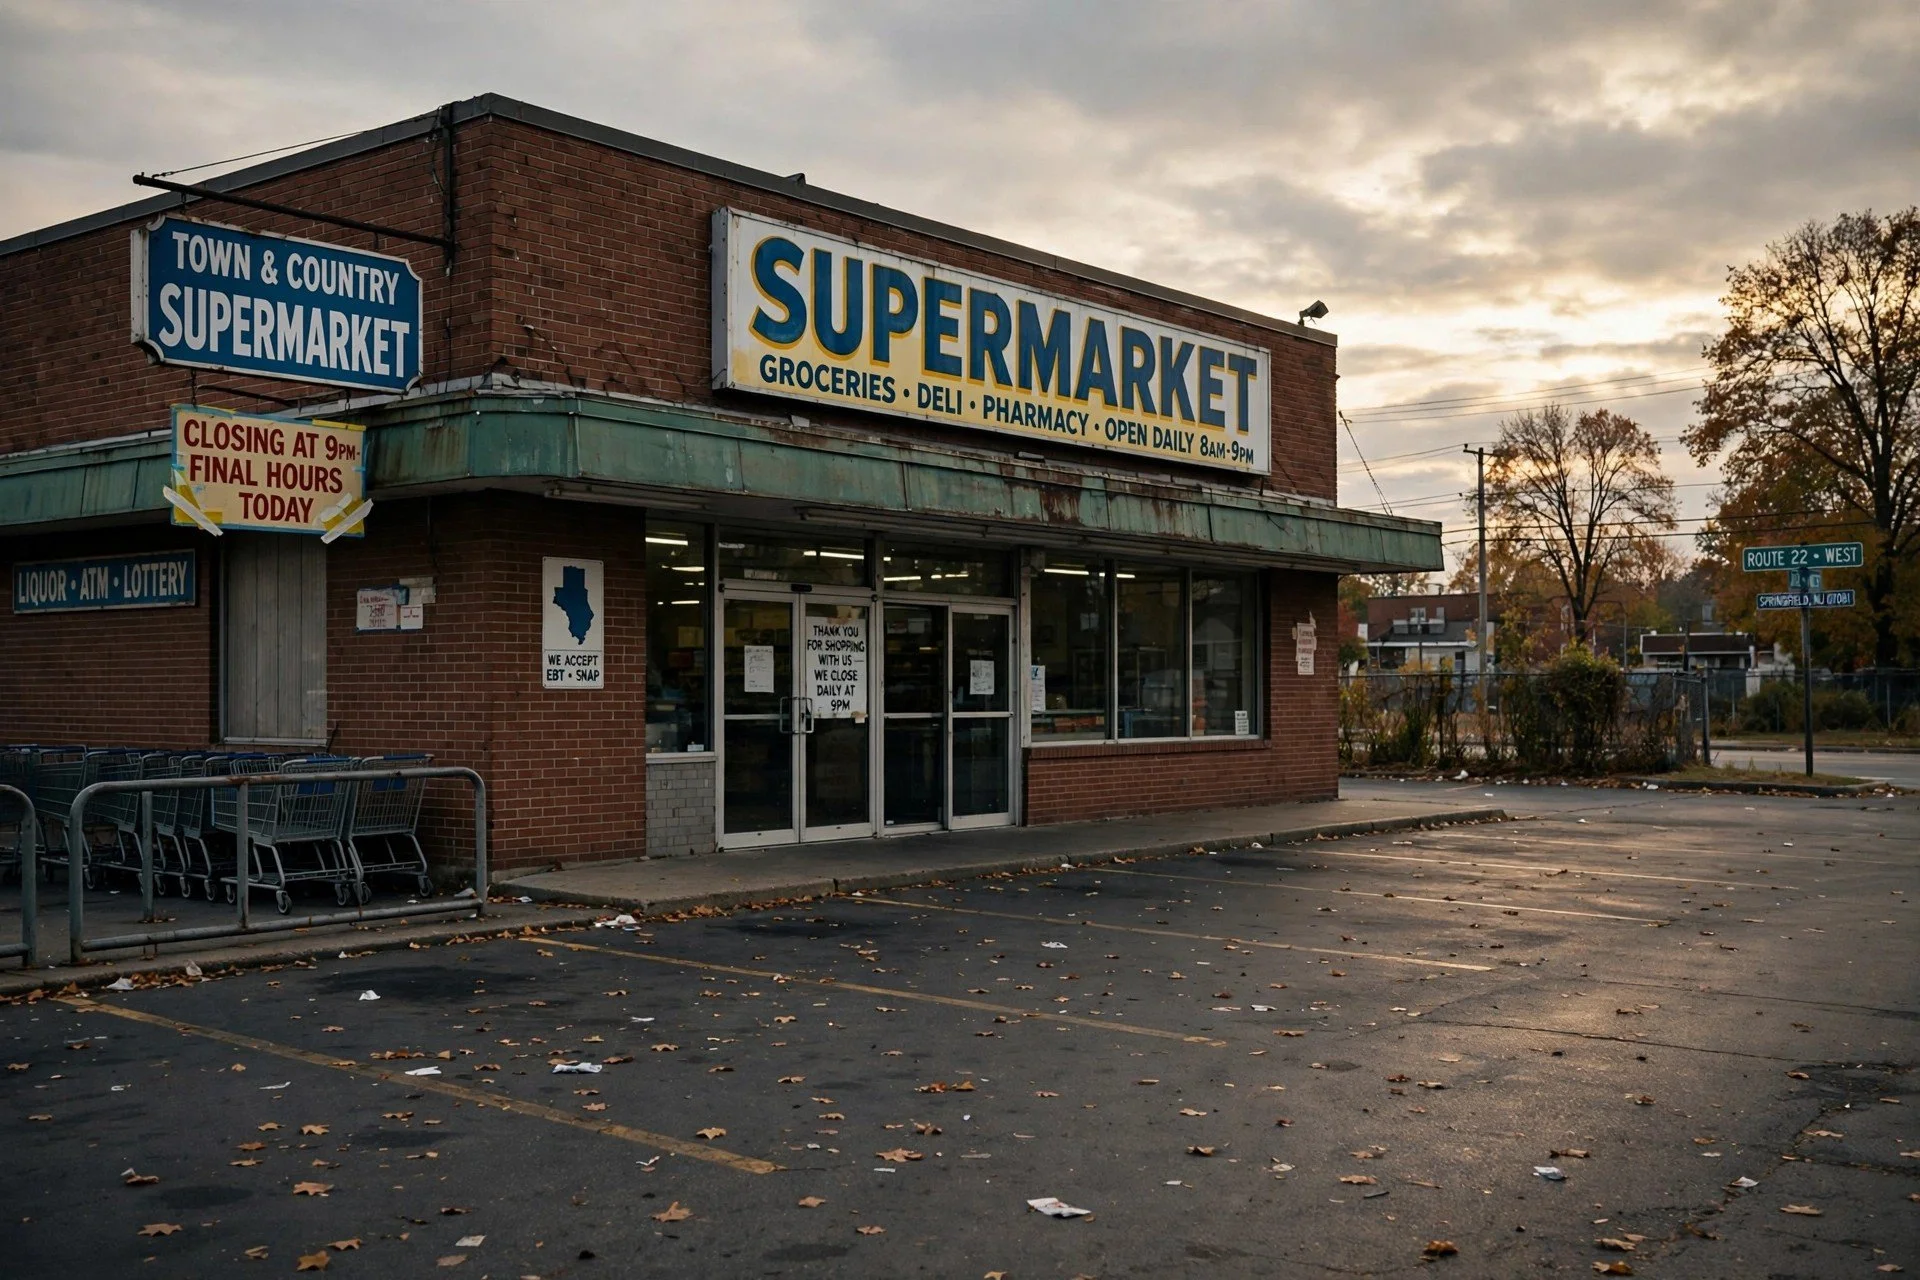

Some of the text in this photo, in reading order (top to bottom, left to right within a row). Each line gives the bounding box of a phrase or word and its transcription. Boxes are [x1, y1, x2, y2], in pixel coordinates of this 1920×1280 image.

[172, 231, 400, 305] TOWN & COUNTRY
[158, 283, 410, 378] SUPERMARKET
[749, 236, 1257, 436] SUPERMARKET
[759, 354, 1254, 465] GROCERIES DELI PHARMACY OPEN DAILY 8AM-9PM
[184, 419, 285, 455] CLOSING
[292, 431, 319, 459] AT
[189, 454, 343, 494] FINAL HOURS
[238, 492, 314, 524] TODAY
[1747, 547, 1857, 567] ROUTE 22 WEST
[18, 561, 188, 606] LIQUOR ATM LOTTERY
[1814, 594, 1824, 605] NJ
[813, 625, 859, 638] THANK YOU
[807, 639, 865, 652] FOR SHOPPING
[548, 654, 598, 666] WE ACCEPT
[818, 654, 852, 666] WITH US
[546, 668, 600, 682] EBT SNAP
[814, 669, 858, 682] WE CLOSE
[816, 684, 856, 696] DAILY AT
[830, 699, 850, 711] 9PM
